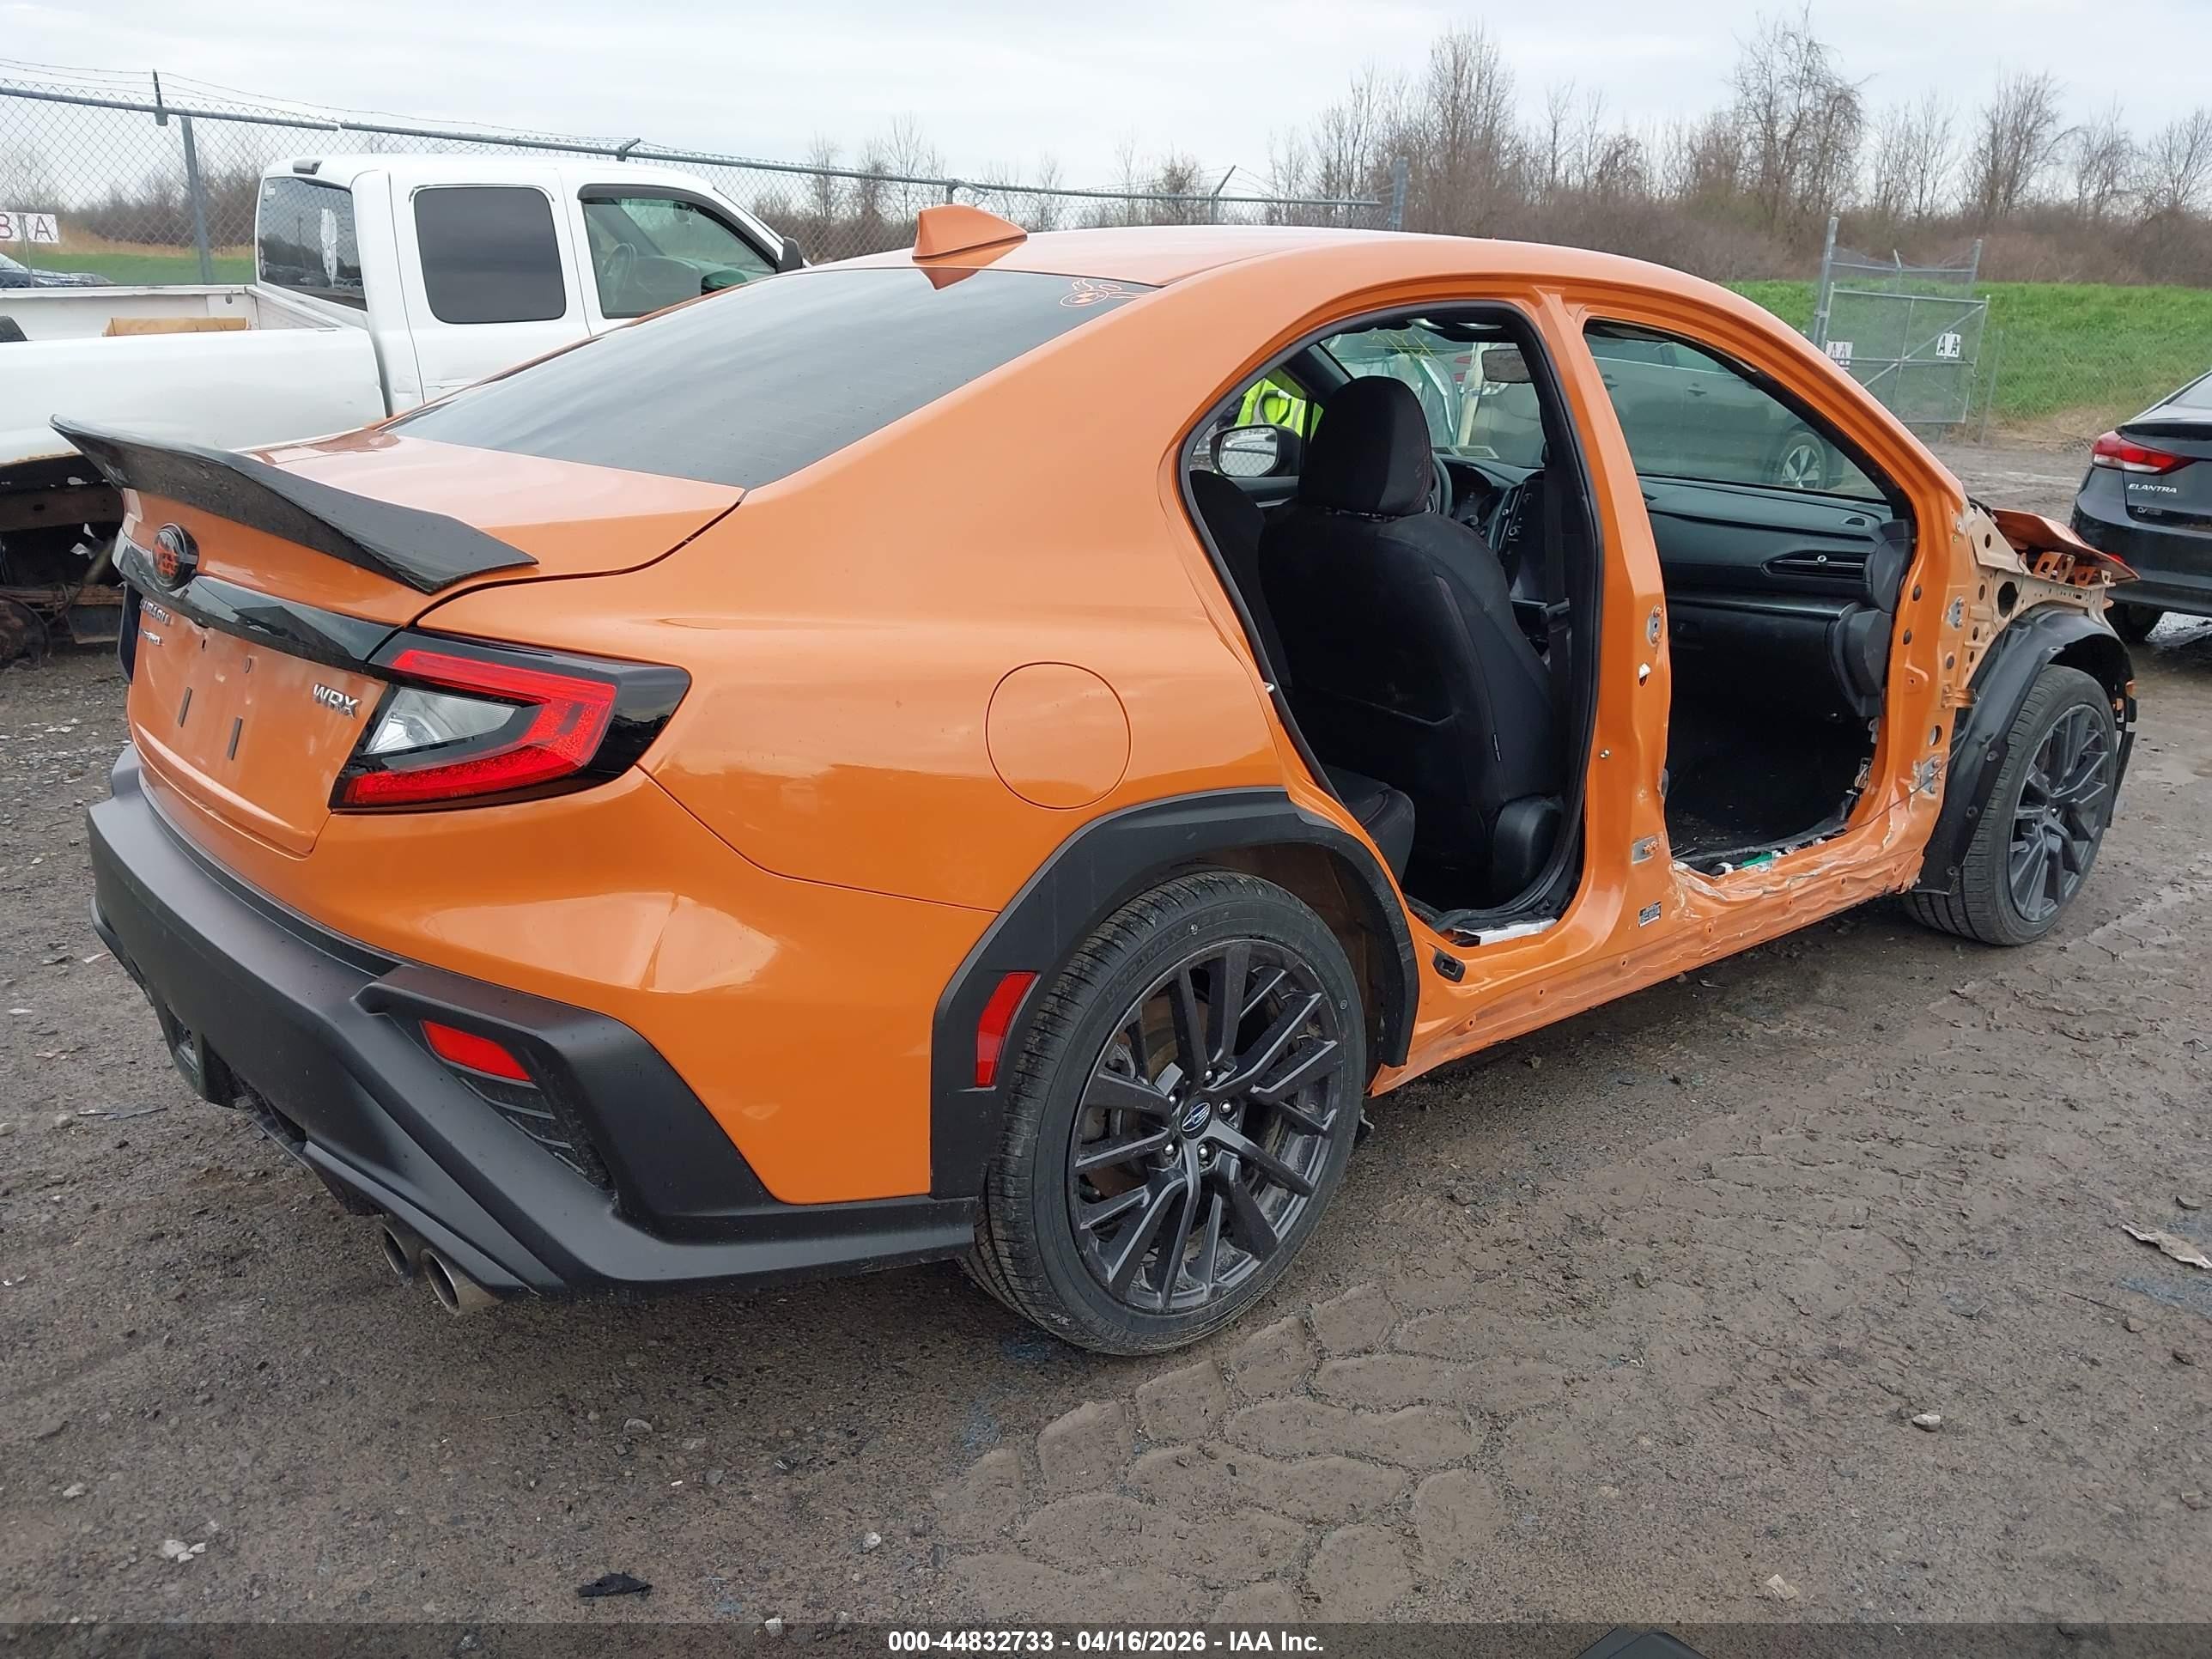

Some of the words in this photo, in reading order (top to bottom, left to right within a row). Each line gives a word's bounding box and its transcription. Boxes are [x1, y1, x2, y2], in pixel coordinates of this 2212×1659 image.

[33, 216, 53, 241] A
[2128, 483, 2178, 494] ELANTRA
[139, 598, 170, 626] SUBARU
[313, 683, 362, 720] WRX
